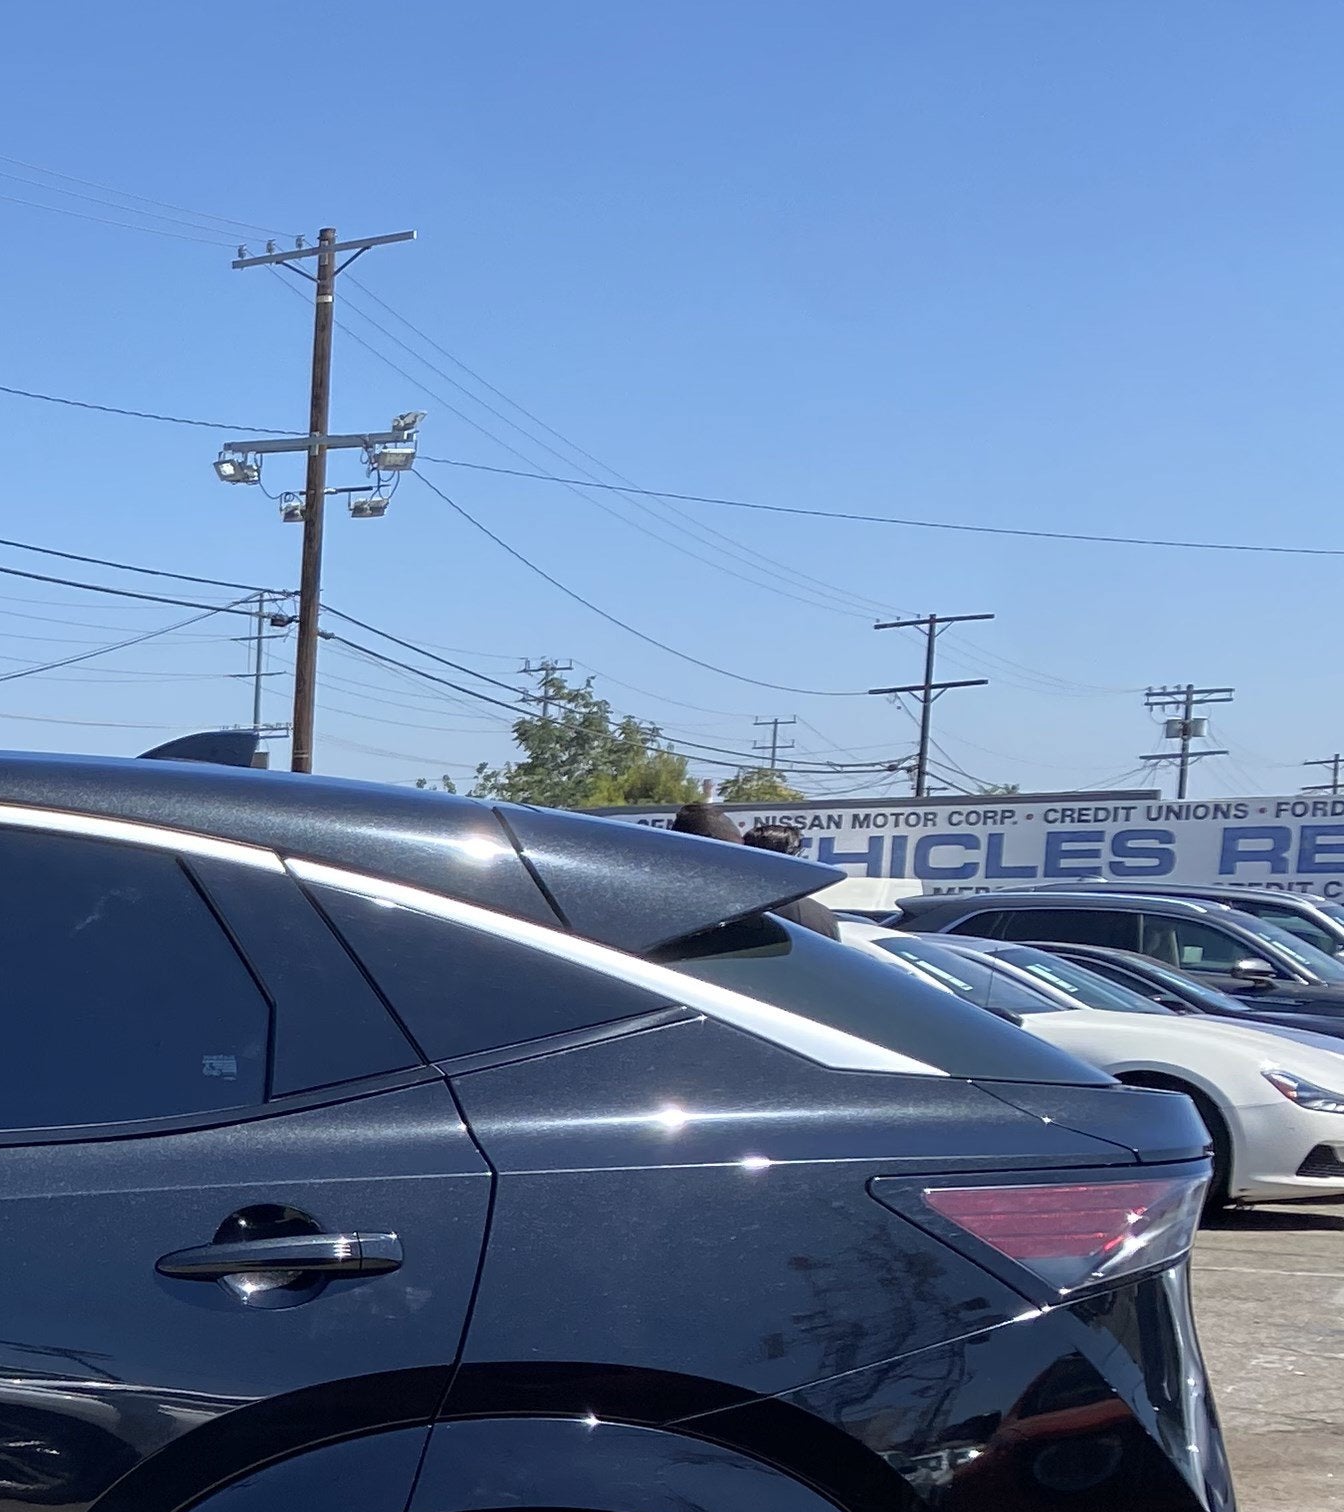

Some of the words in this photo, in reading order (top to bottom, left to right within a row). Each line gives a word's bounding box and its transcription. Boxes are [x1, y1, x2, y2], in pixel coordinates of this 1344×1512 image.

[851, 811, 938, 829] MOTOR
[948, 809, 1018, 827] CORP.
[1043, 806, 1138, 824] CREDIT
[1146, 802, 1250, 823] UNIONS
